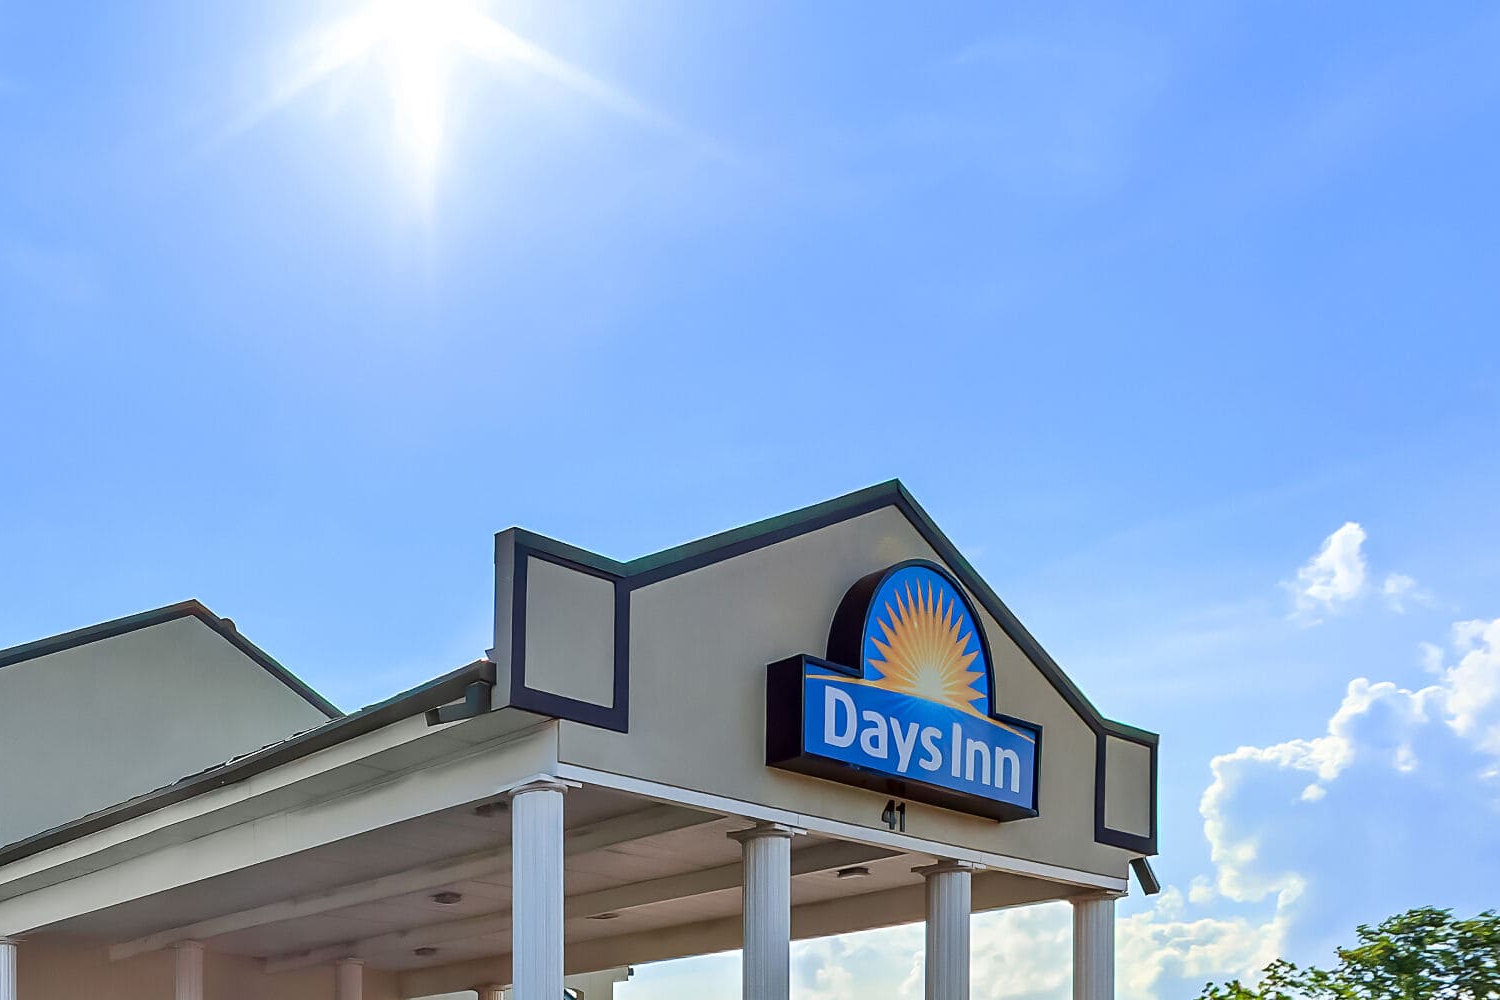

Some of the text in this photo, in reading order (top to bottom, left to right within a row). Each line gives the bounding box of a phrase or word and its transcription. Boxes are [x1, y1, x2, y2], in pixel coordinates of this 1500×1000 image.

[823, 684, 1021, 794] Days Inn
[881, 799, 906, 833] 41
